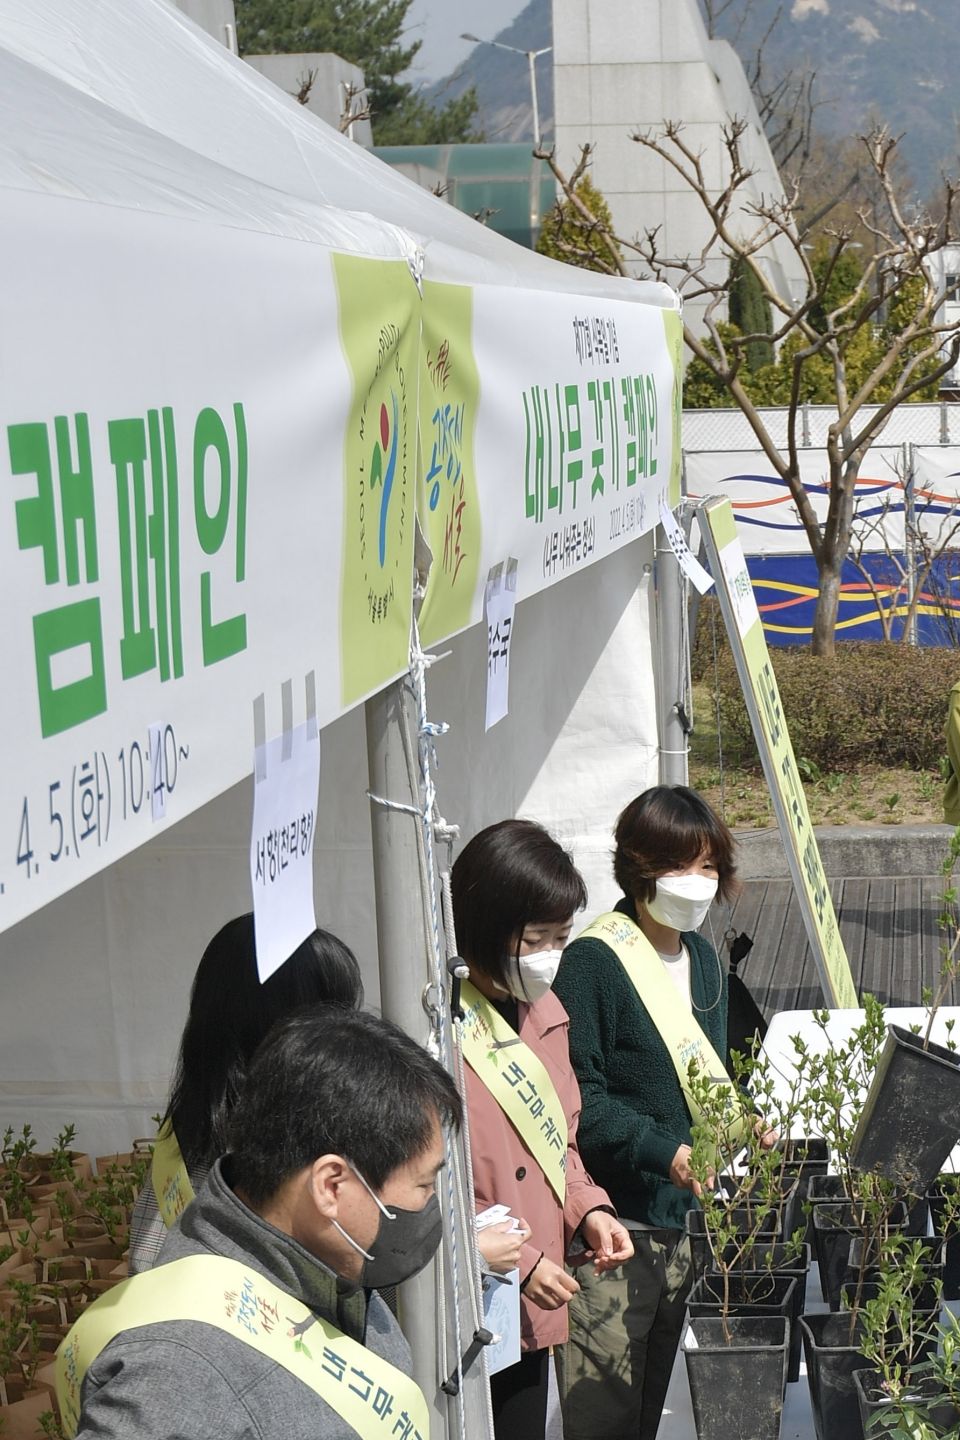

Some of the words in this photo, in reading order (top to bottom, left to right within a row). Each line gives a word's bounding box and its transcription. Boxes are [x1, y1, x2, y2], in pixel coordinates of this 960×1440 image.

[587, 377, 619, 501] 갖기
[621, 373, 658, 487] 캠페인
[7, 402, 249, 738] 캠페인
[254, 809, 315, 886] 서향(천리향)
[257, 1296, 280, 1335] 서울
[321, 1346, 394, 1421] 내나무
